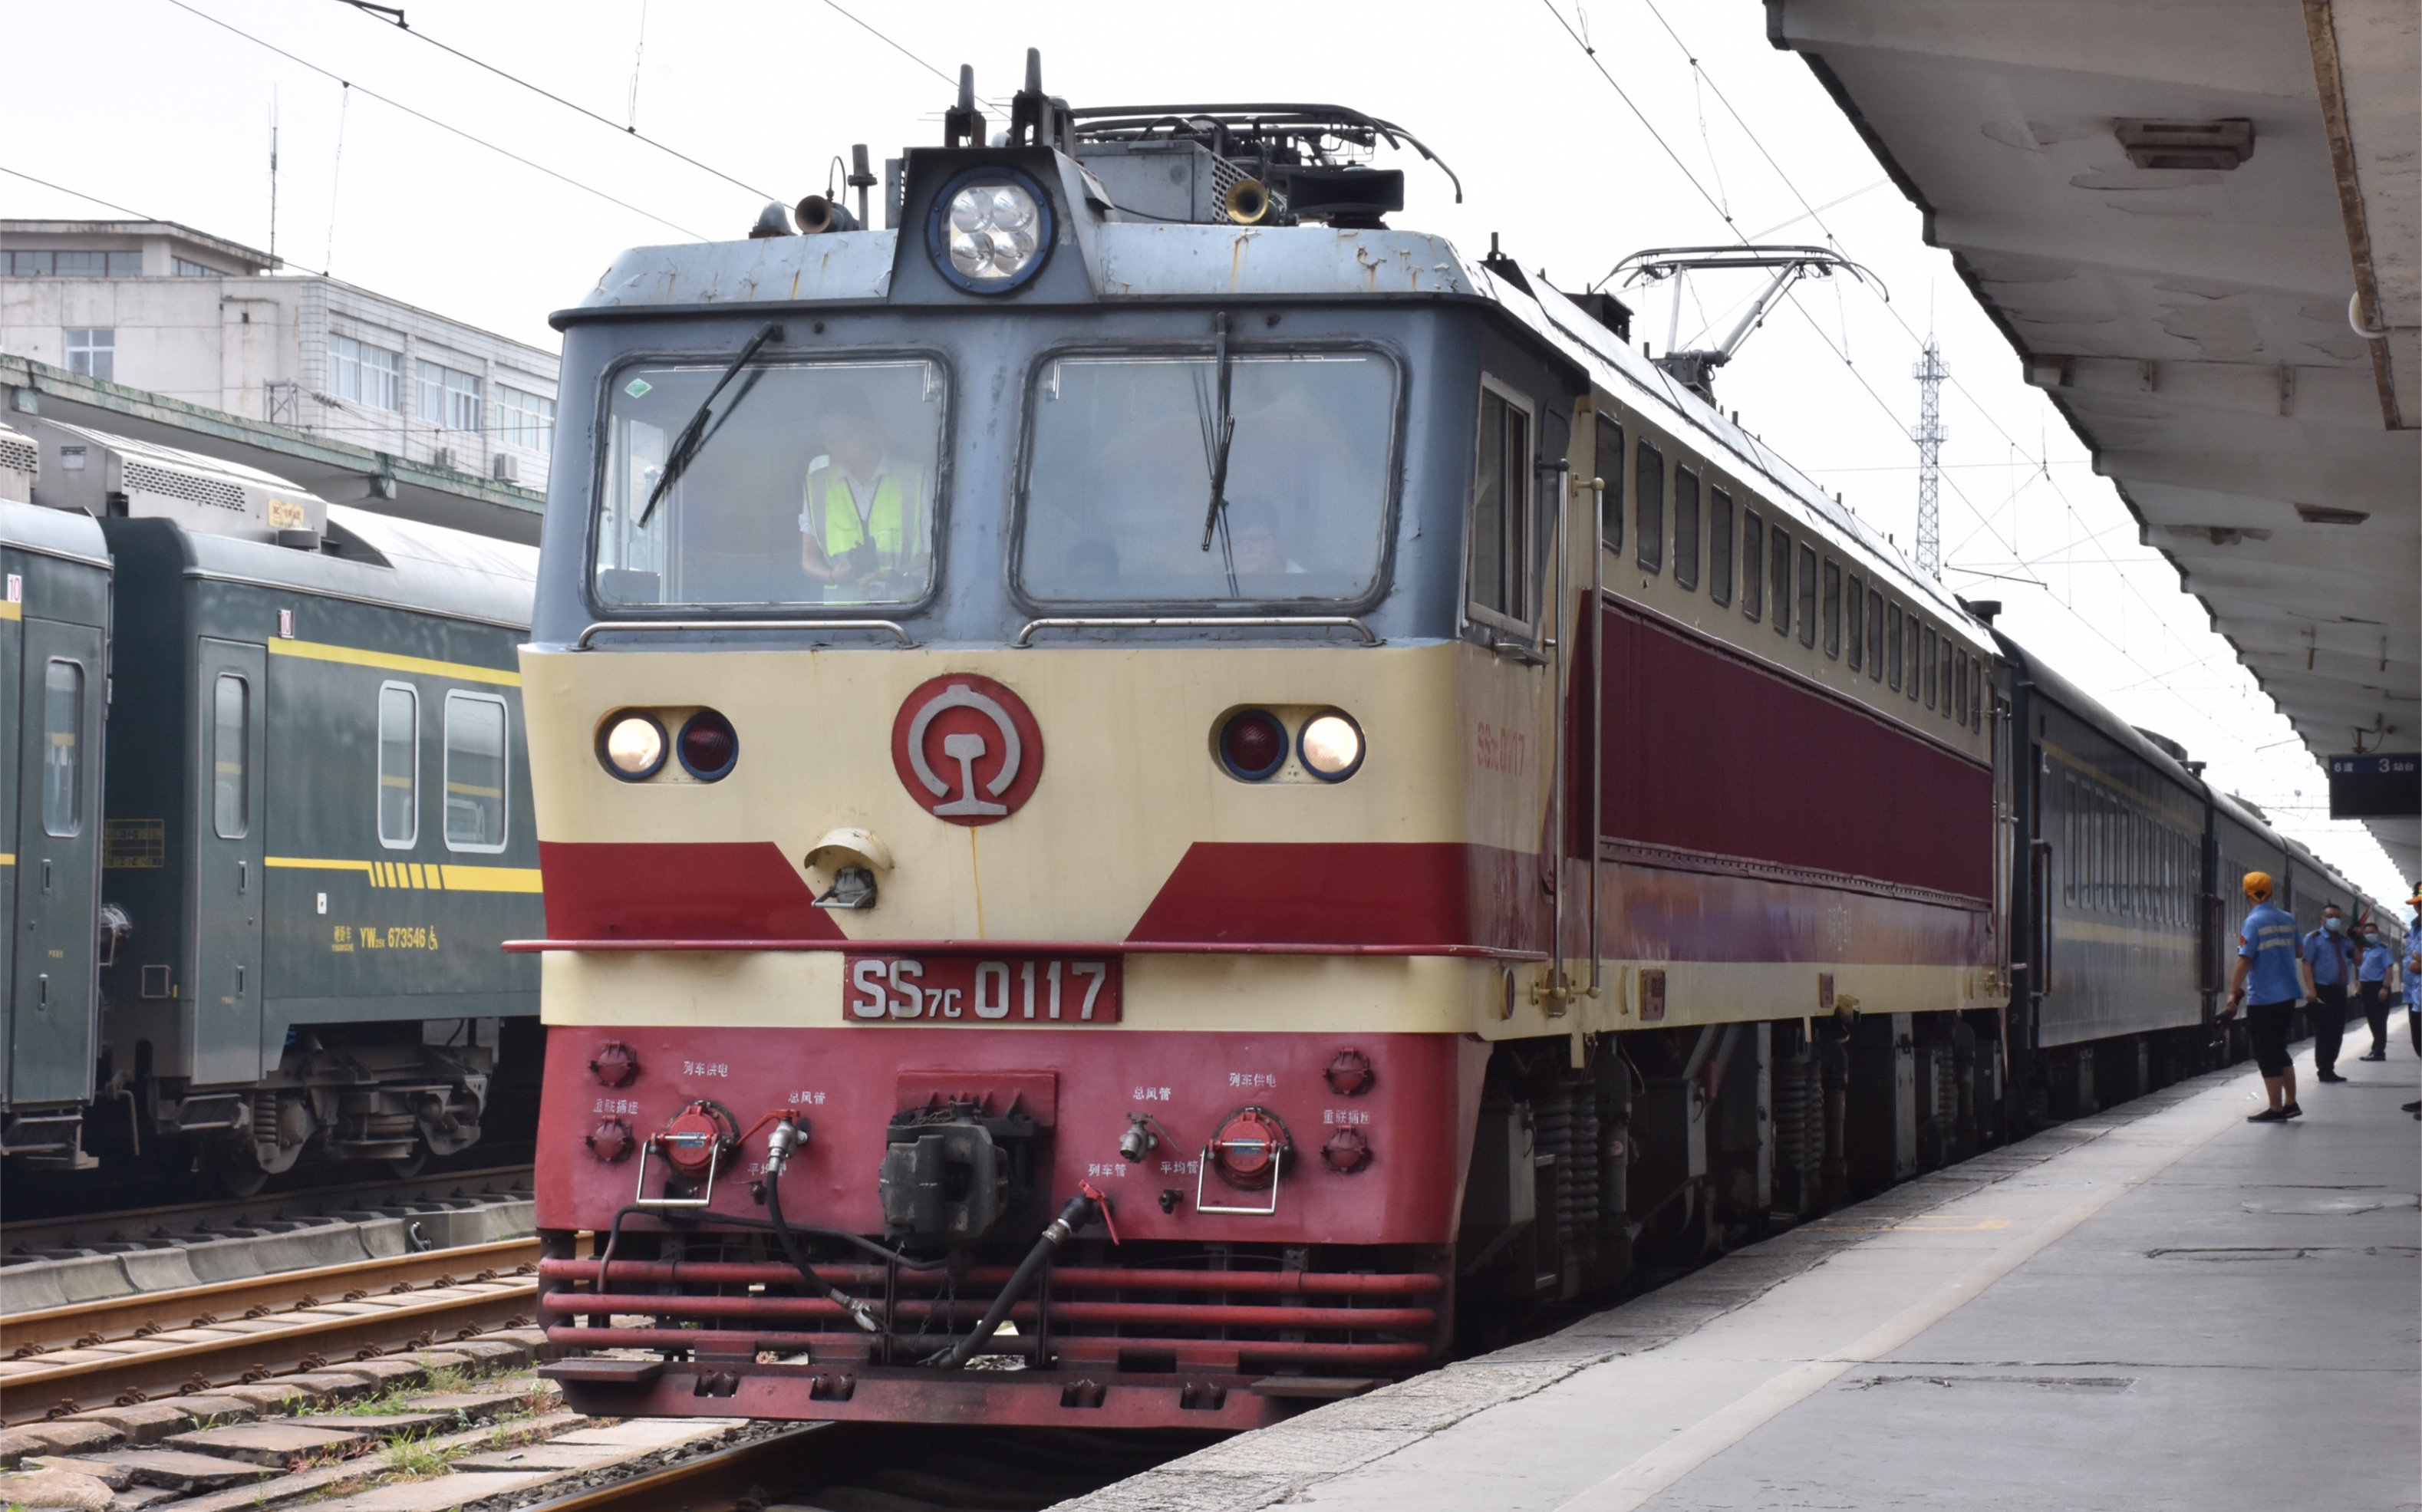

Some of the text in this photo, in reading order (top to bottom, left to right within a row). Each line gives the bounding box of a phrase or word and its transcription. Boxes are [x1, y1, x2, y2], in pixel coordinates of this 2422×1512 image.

[9, 577, 21, 601] 10
[282, 612, 291, 634] 10
[387, 927, 426, 949] 673546
[853, 960, 1106, 1020] SS7C 0117
[2010, 1013, 2019, 1024] 2
[683, 1061, 728, 1077] 列车供电
[1229, 1072, 1277, 1088] 列车供电
[788, 1090, 826, 1105] 总风管
[1132, 1086, 1171, 1101] 总风管
[1323, 1109, 1372, 1124] 重联插座
[1088, 1163, 1127, 1178] 列车管
[1160, 1160, 1199, 1175] 平均管
